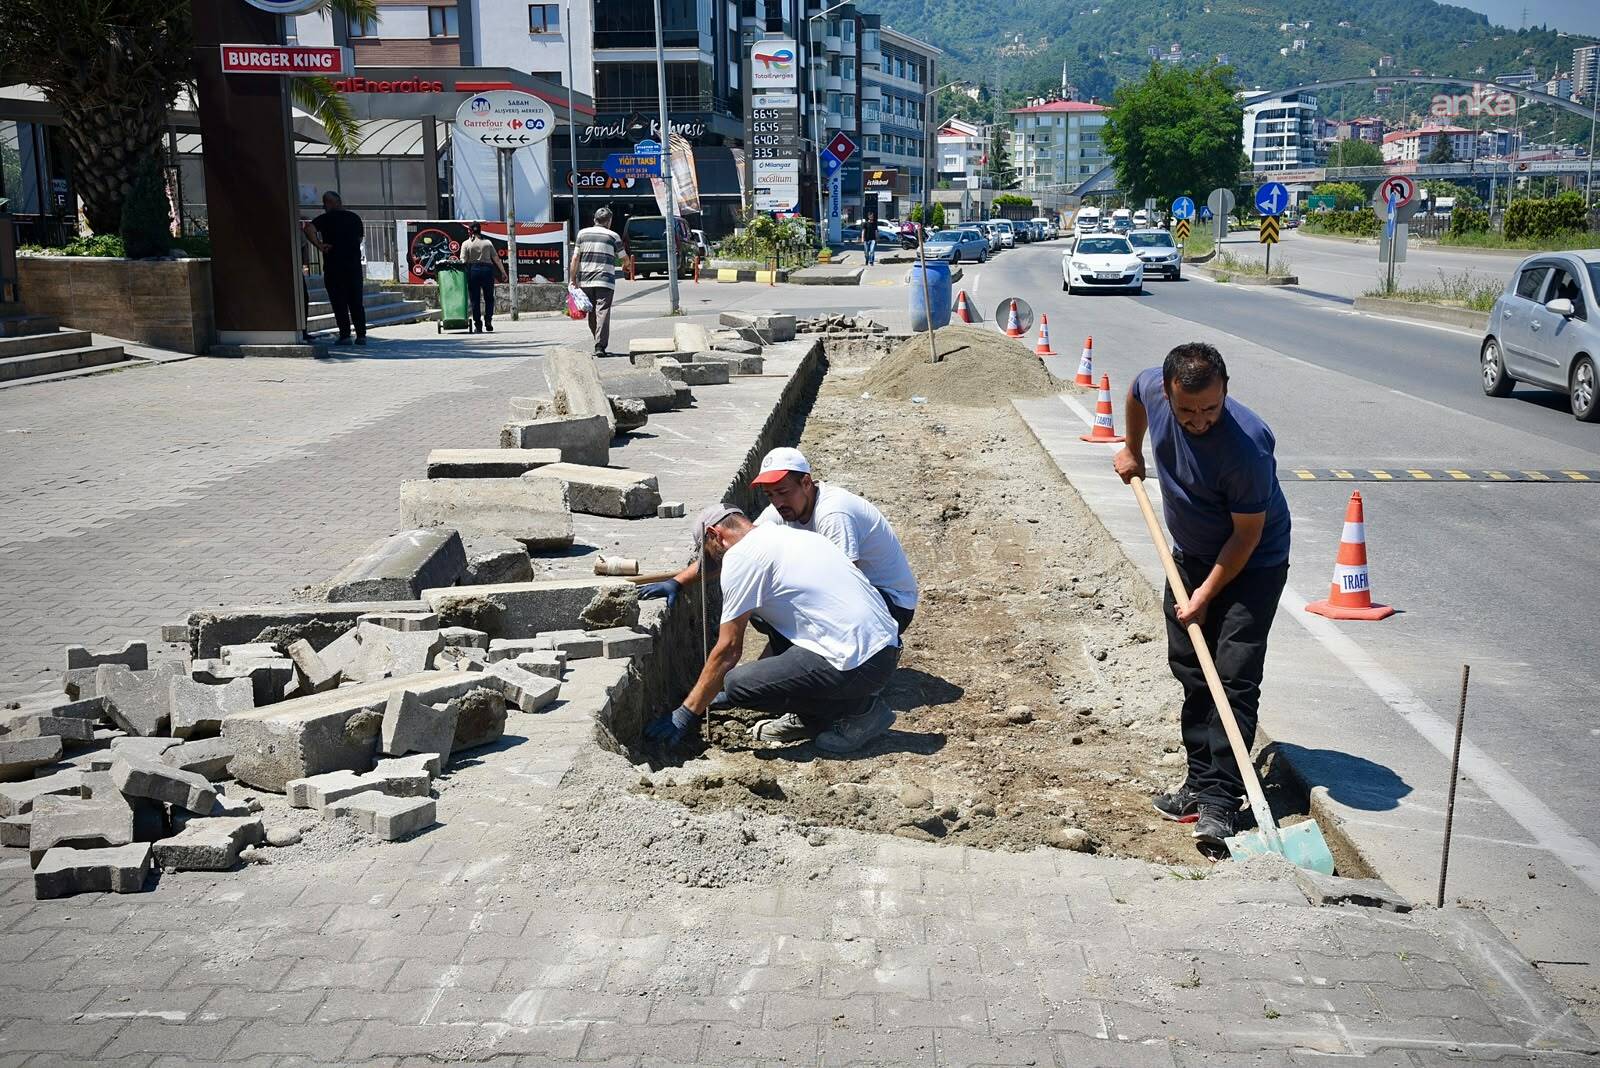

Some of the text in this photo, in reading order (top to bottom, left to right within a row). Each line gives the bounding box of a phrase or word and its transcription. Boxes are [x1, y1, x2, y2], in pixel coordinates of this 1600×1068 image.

[229, 52, 332, 67] BURGER KING
[330, 76, 443, 94] alEnergies
[753, 109, 779, 119] 66.45
[463, 119, 504, 128] Carrefour
[650, 119, 705, 136] khvesi
[753, 122, 779, 132] 66.45
[753, 135, 779, 145] 64.02
[637, 156, 657, 166] TAKSİ
[570, 171, 605, 186] Cafe
[831, 177, 839, 218] Domino's
[518, 248, 560, 258] ELEKTRİK
